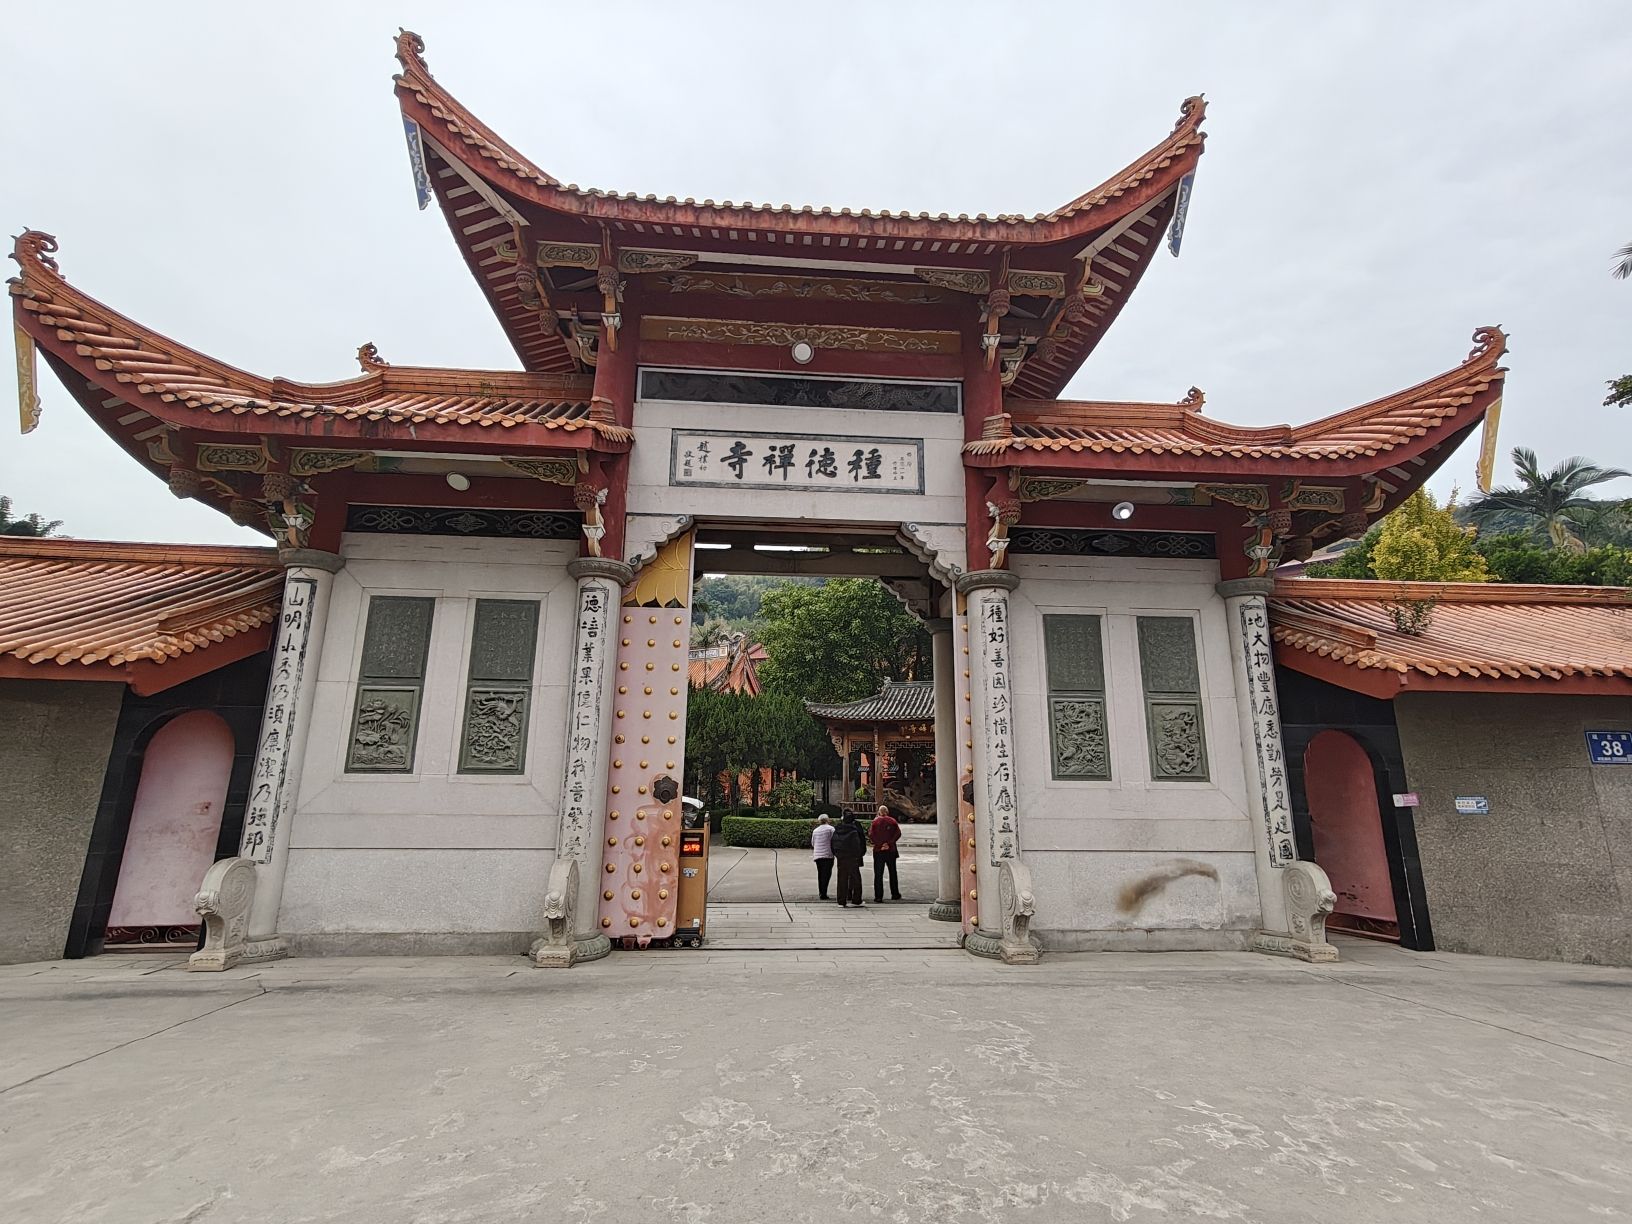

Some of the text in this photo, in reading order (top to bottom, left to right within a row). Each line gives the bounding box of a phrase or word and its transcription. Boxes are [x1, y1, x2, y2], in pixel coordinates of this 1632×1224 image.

[720, 441, 883, 483] 種德禪寺
[1601, 740, 1624, 756] 38
